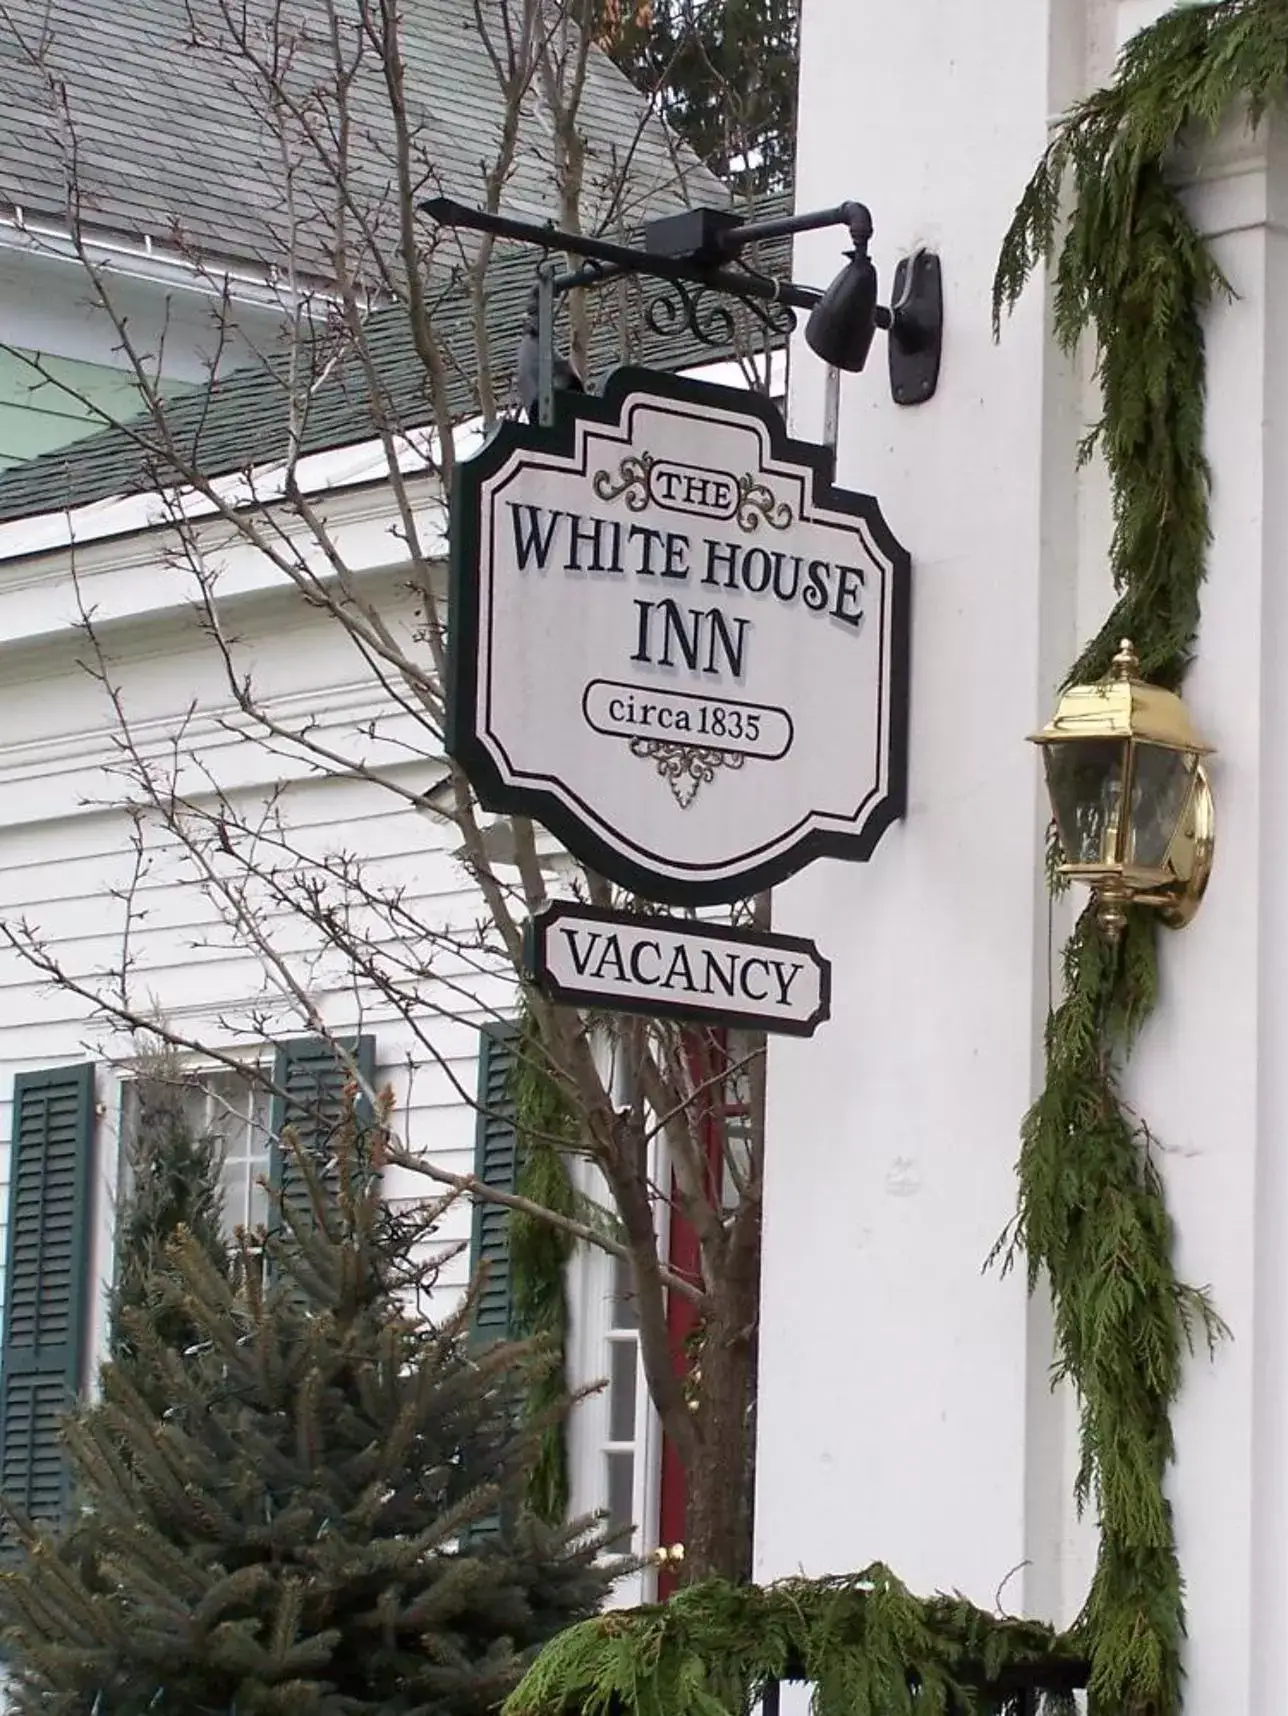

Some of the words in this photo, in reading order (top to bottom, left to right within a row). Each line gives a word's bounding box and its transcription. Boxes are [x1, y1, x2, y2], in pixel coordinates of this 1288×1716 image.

[656, 471, 734, 510] THE
[505, 501, 691, 580] WHITE
[701, 538, 867, 627] HOUSE
[630, 598, 752, 677] INN
[609, 694, 691, 731] circa
[697, 706, 762, 740] 1835
[559, 927, 804, 1006] VACANCY
